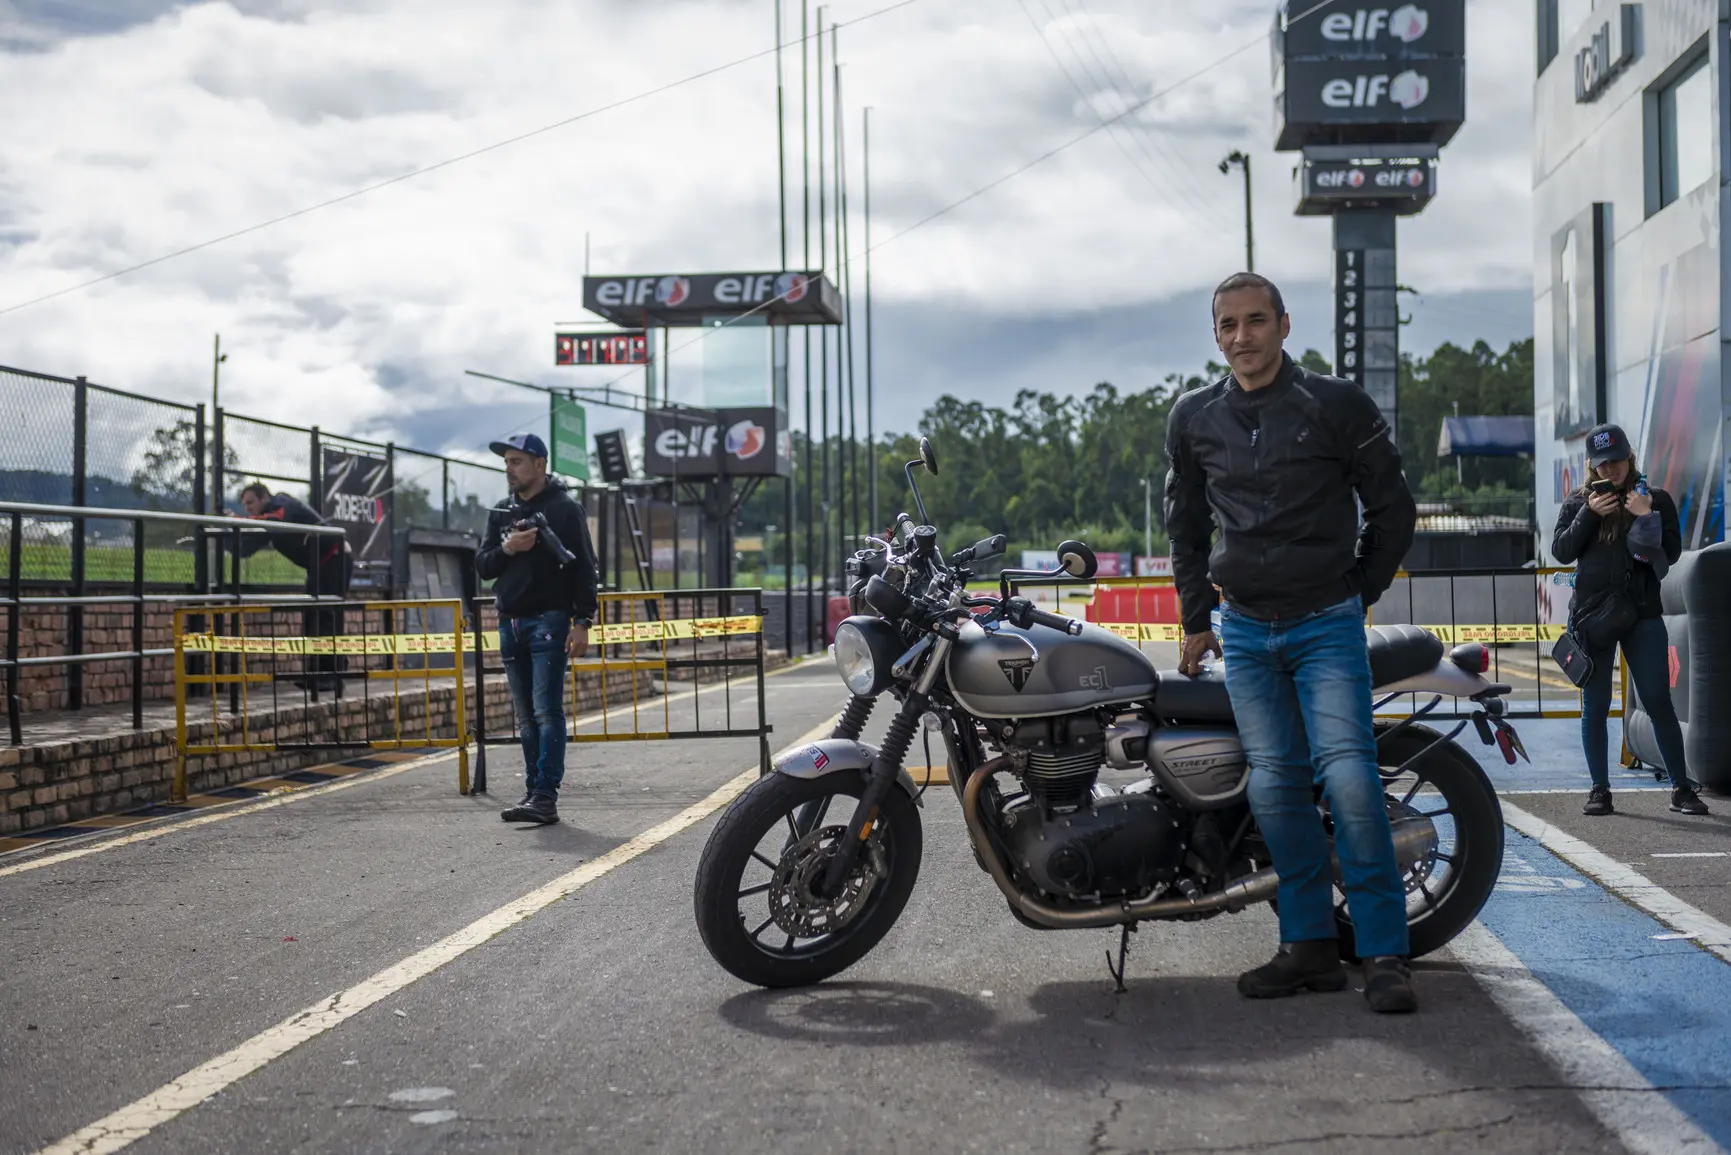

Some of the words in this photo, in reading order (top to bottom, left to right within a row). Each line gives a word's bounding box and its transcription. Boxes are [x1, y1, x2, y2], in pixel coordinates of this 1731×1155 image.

[1320, 9, 1389, 41] elf
[1321, 74, 1389, 107] elf
[1316, 170, 1350, 187] elf
[1375, 170, 1407, 187] elf
[1345, 251, 1355, 267] 1
[1344, 270, 1357, 286] 2
[595, 278, 656, 306] elf
[713, 275, 773, 304] elf
[1344, 292, 1357, 308] 3
[1344, 310, 1357, 327] 4
[1344, 332, 1356, 349] 5
[1344, 351, 1357, 367] 6
[655, 424, 719, 458] elf
[1171, 758, 1218, 769] STREET
